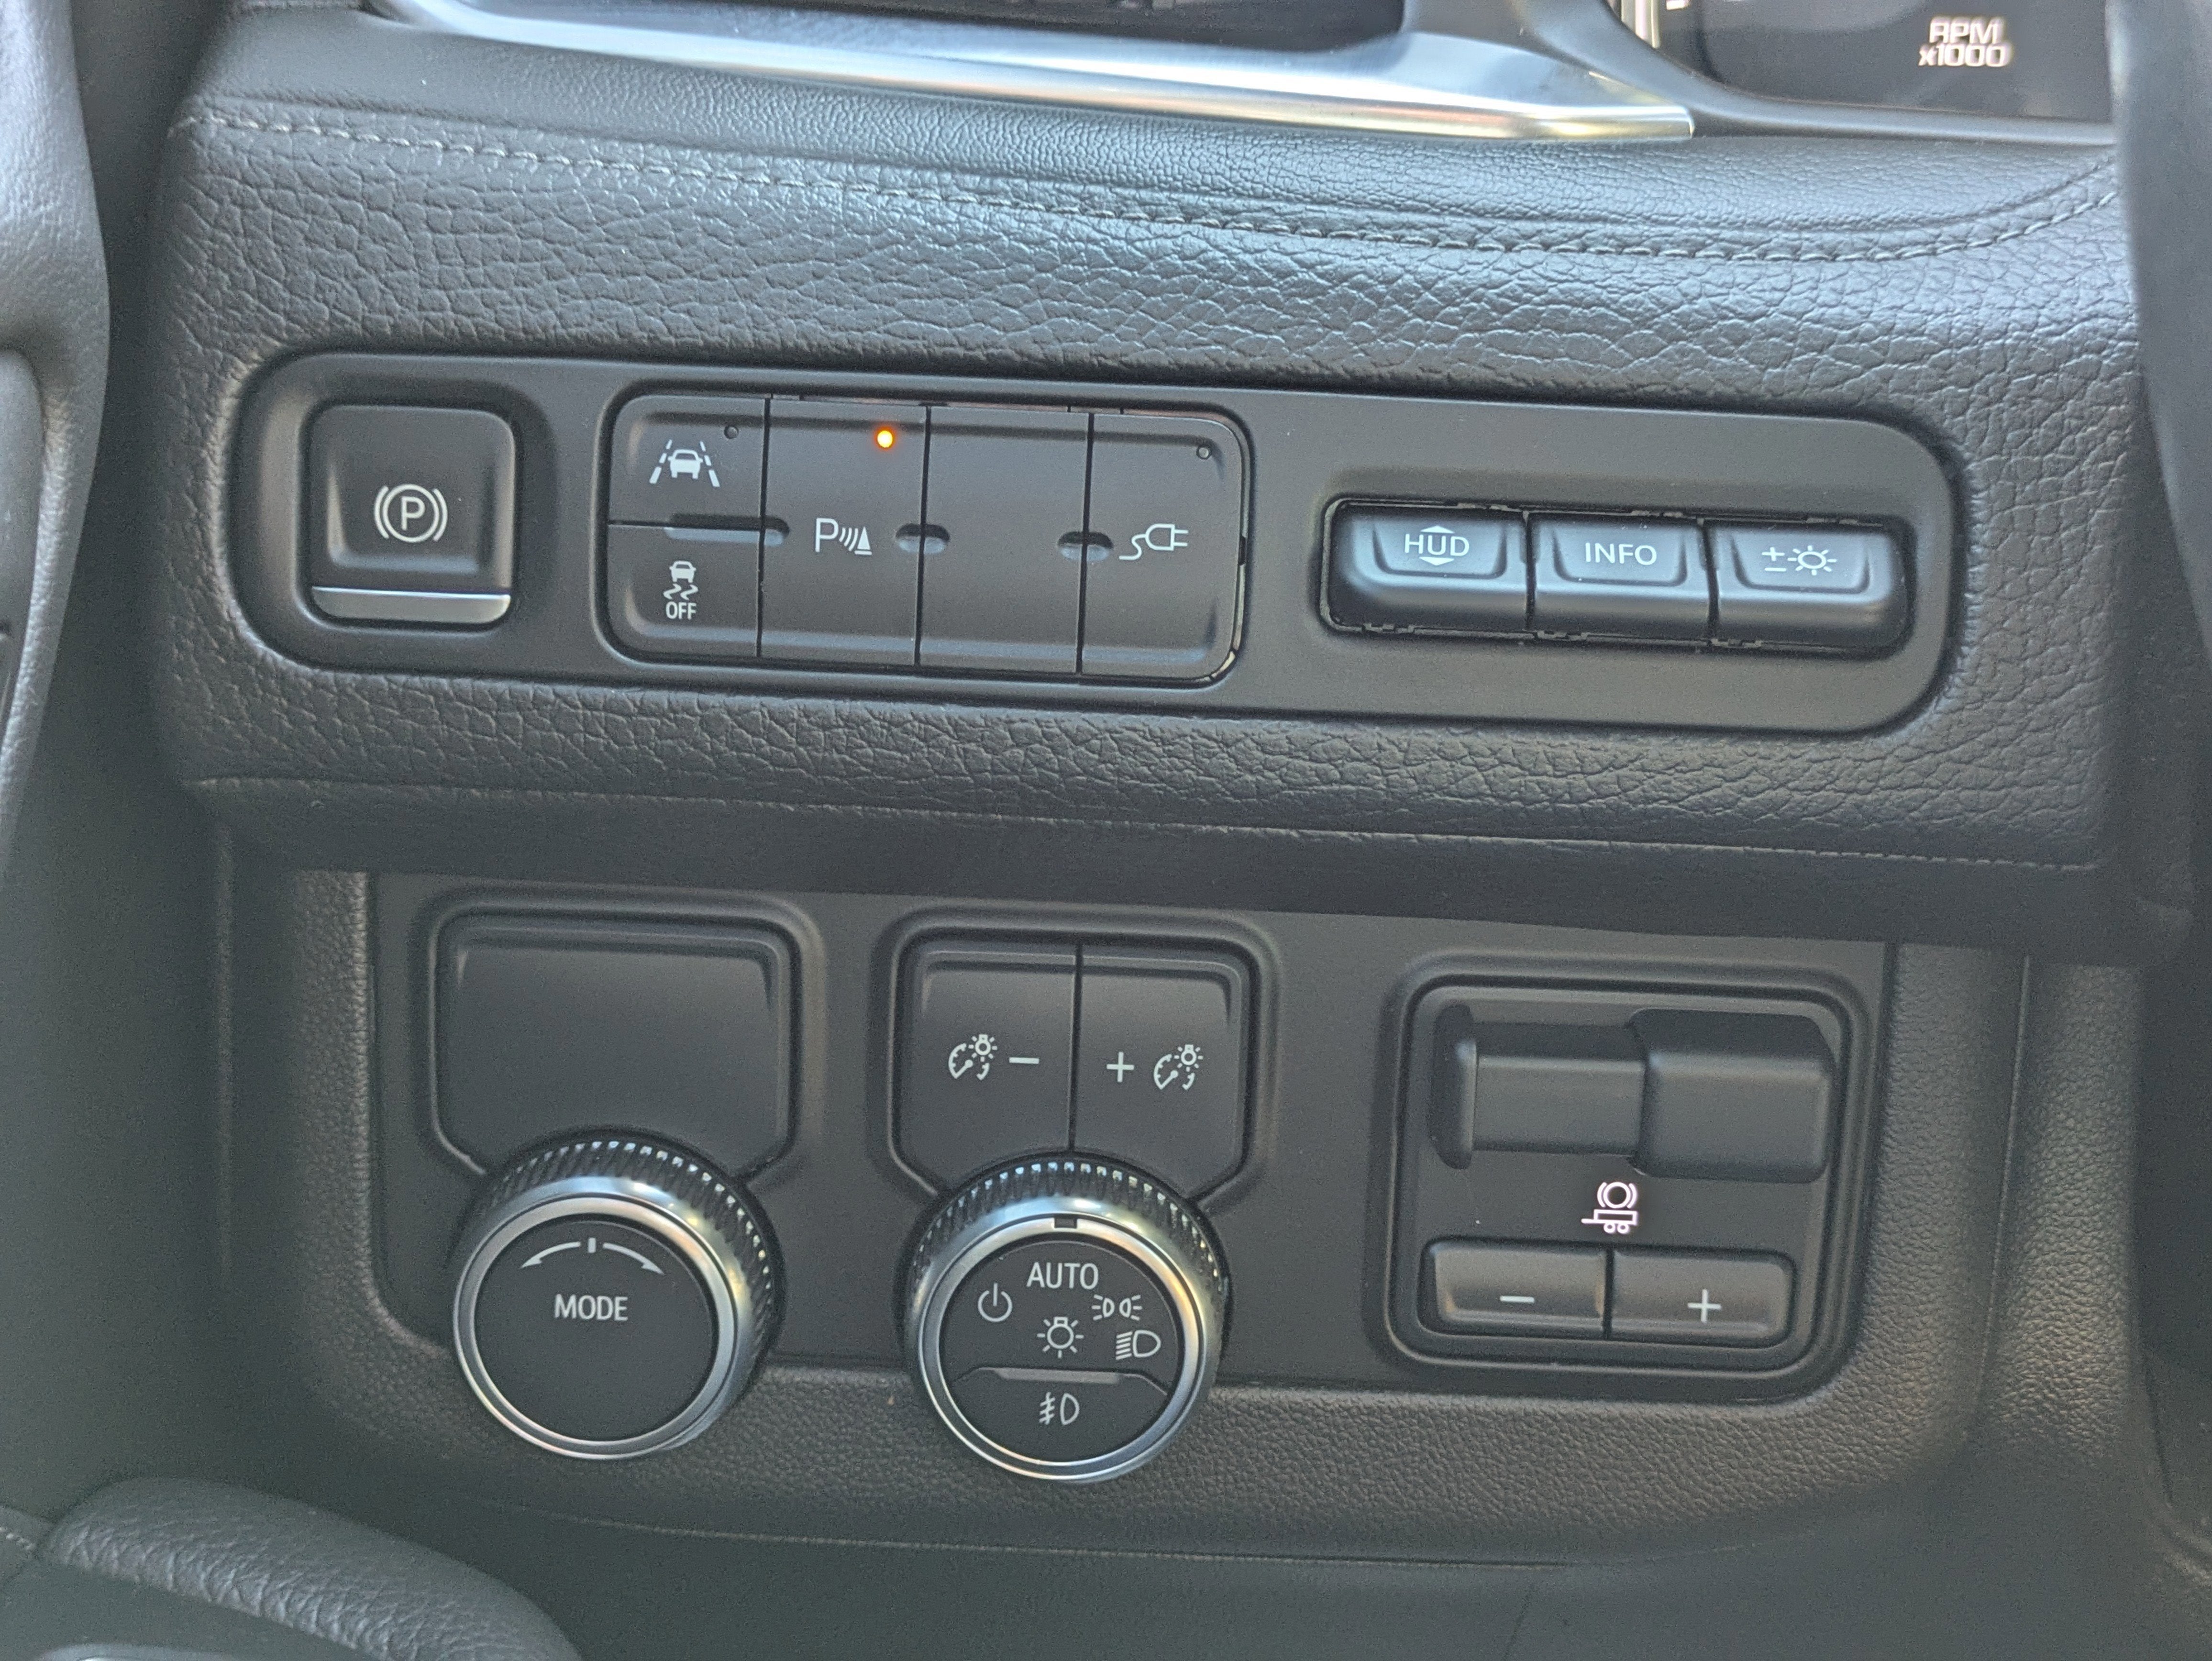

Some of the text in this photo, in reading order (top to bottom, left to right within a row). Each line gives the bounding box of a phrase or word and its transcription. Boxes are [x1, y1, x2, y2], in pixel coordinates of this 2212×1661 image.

[1929, 15, 2004, 44] RPM
[1918, 42, 2013, 67] x1000
[400, 496, 425, 531] P
[815, 518, 839, 553] P
[1405, 533, 1470, 556] HUD
[1585, 543, 1657, 565] INFO
[665, 601, 697, 620] OFF
[1026, 1262, 1099, 1290] AUTO
[554, 1293, 629, 1321] MODE
